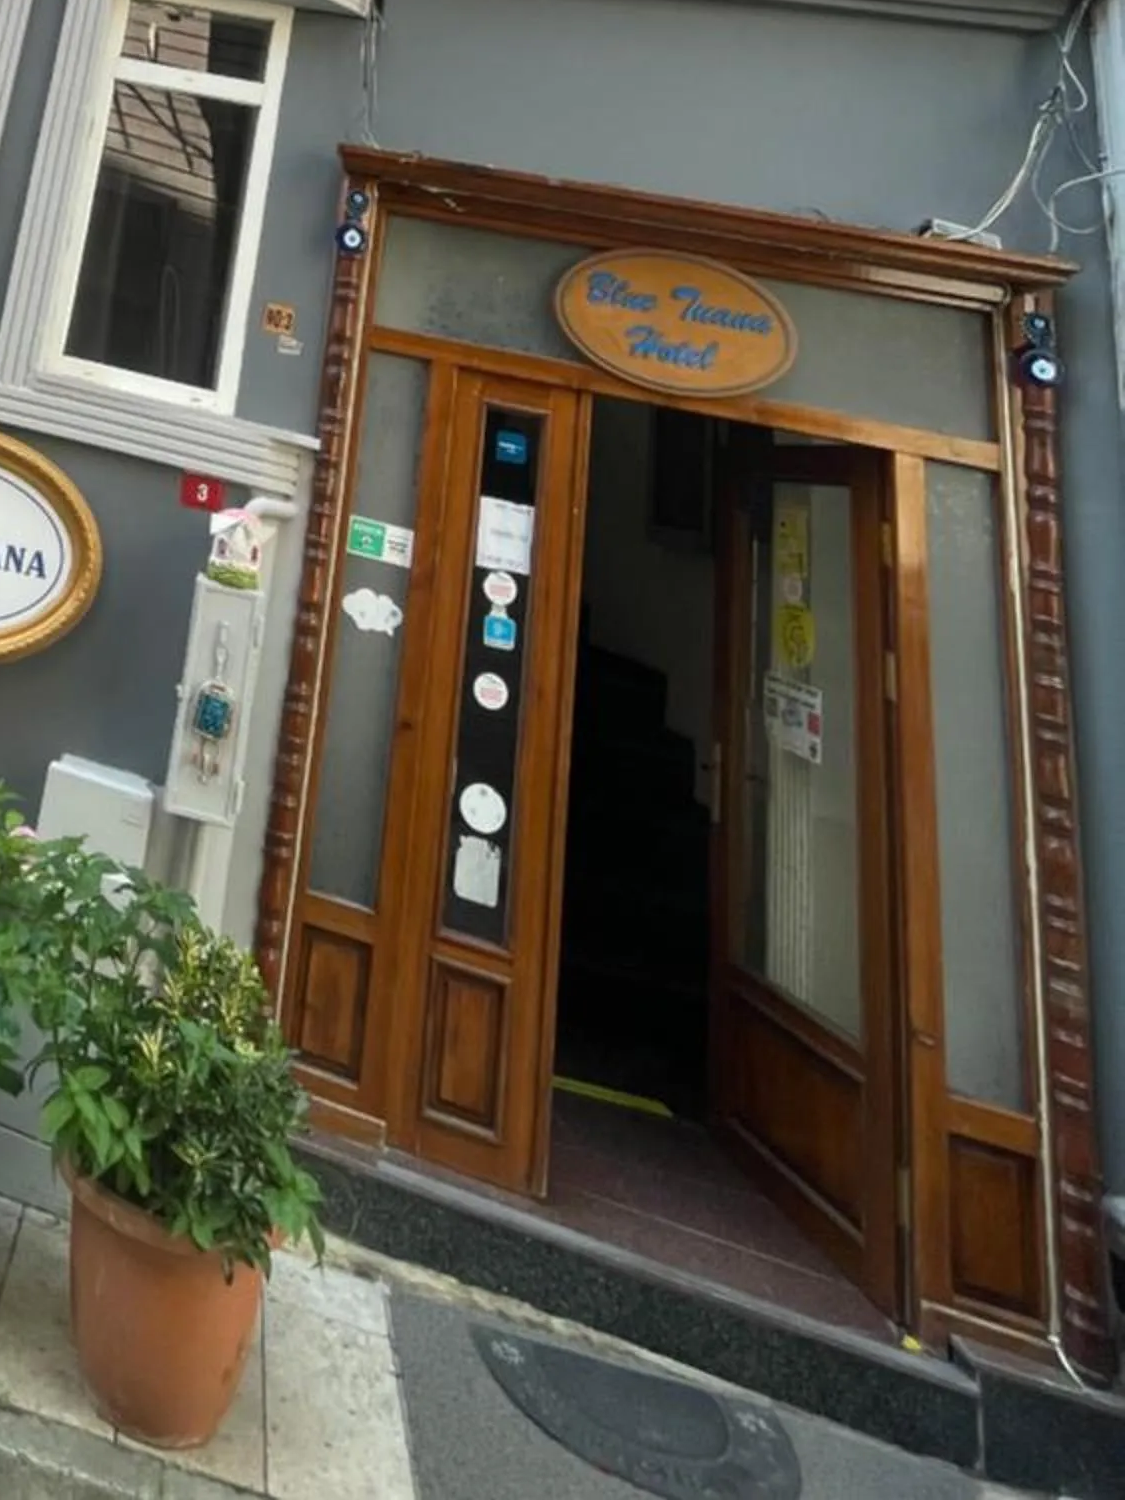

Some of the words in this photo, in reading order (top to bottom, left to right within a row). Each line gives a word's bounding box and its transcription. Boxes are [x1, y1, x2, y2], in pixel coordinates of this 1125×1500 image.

[587, 270, 658, 312] Blue
[671, 286, 773, 335] Tuana
[626, 324, 720, 370] Hotel
[196, 483, 208, 502] 3
